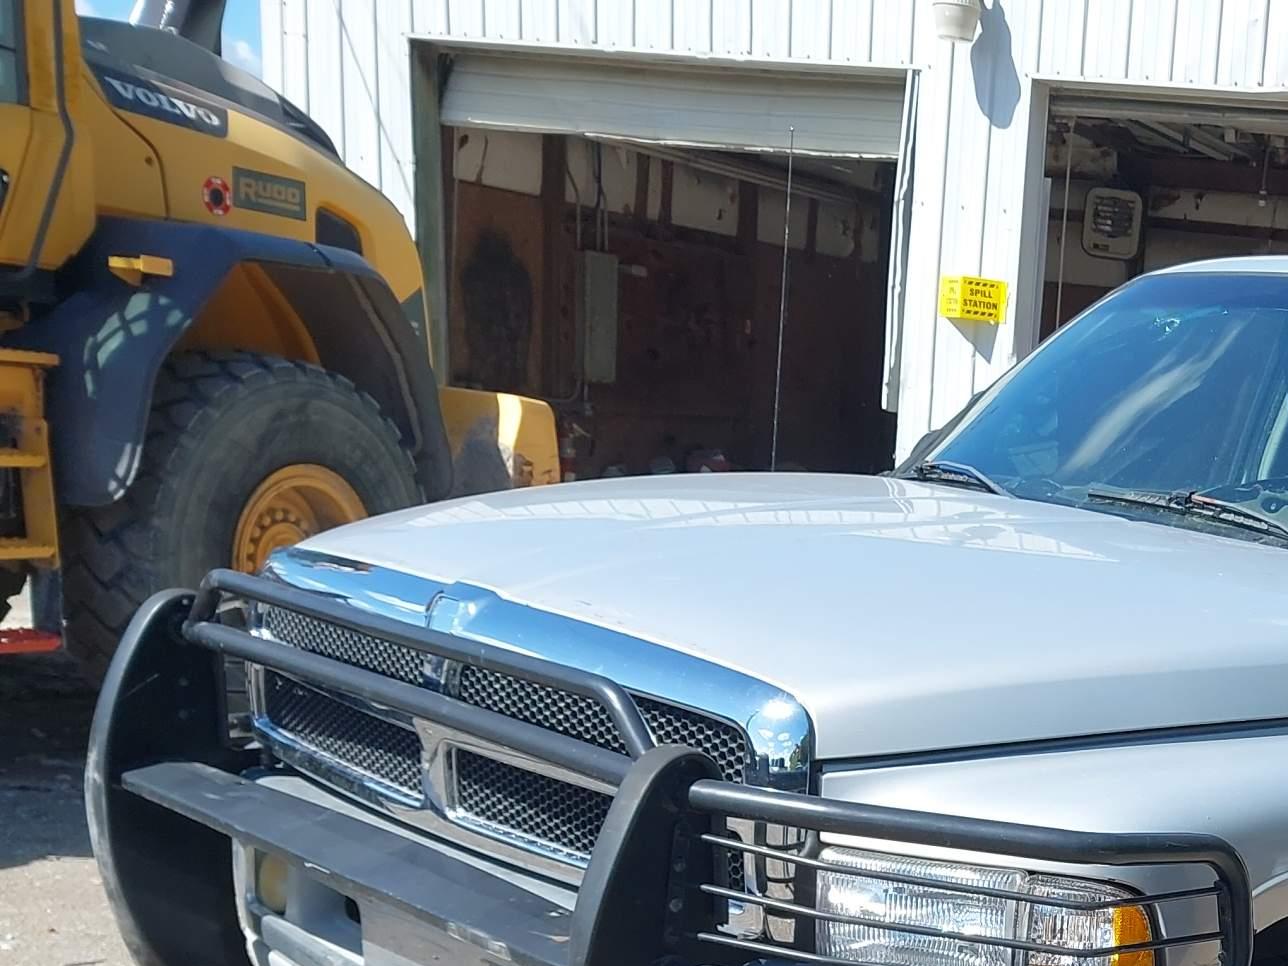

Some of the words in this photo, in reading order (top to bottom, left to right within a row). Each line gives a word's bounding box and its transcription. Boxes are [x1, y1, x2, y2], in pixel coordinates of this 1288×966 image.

[105, 76, 220, 126] VOLVO
[969, 288, 993, 299] SPILL
[963, 299, 998, 310] STATION
